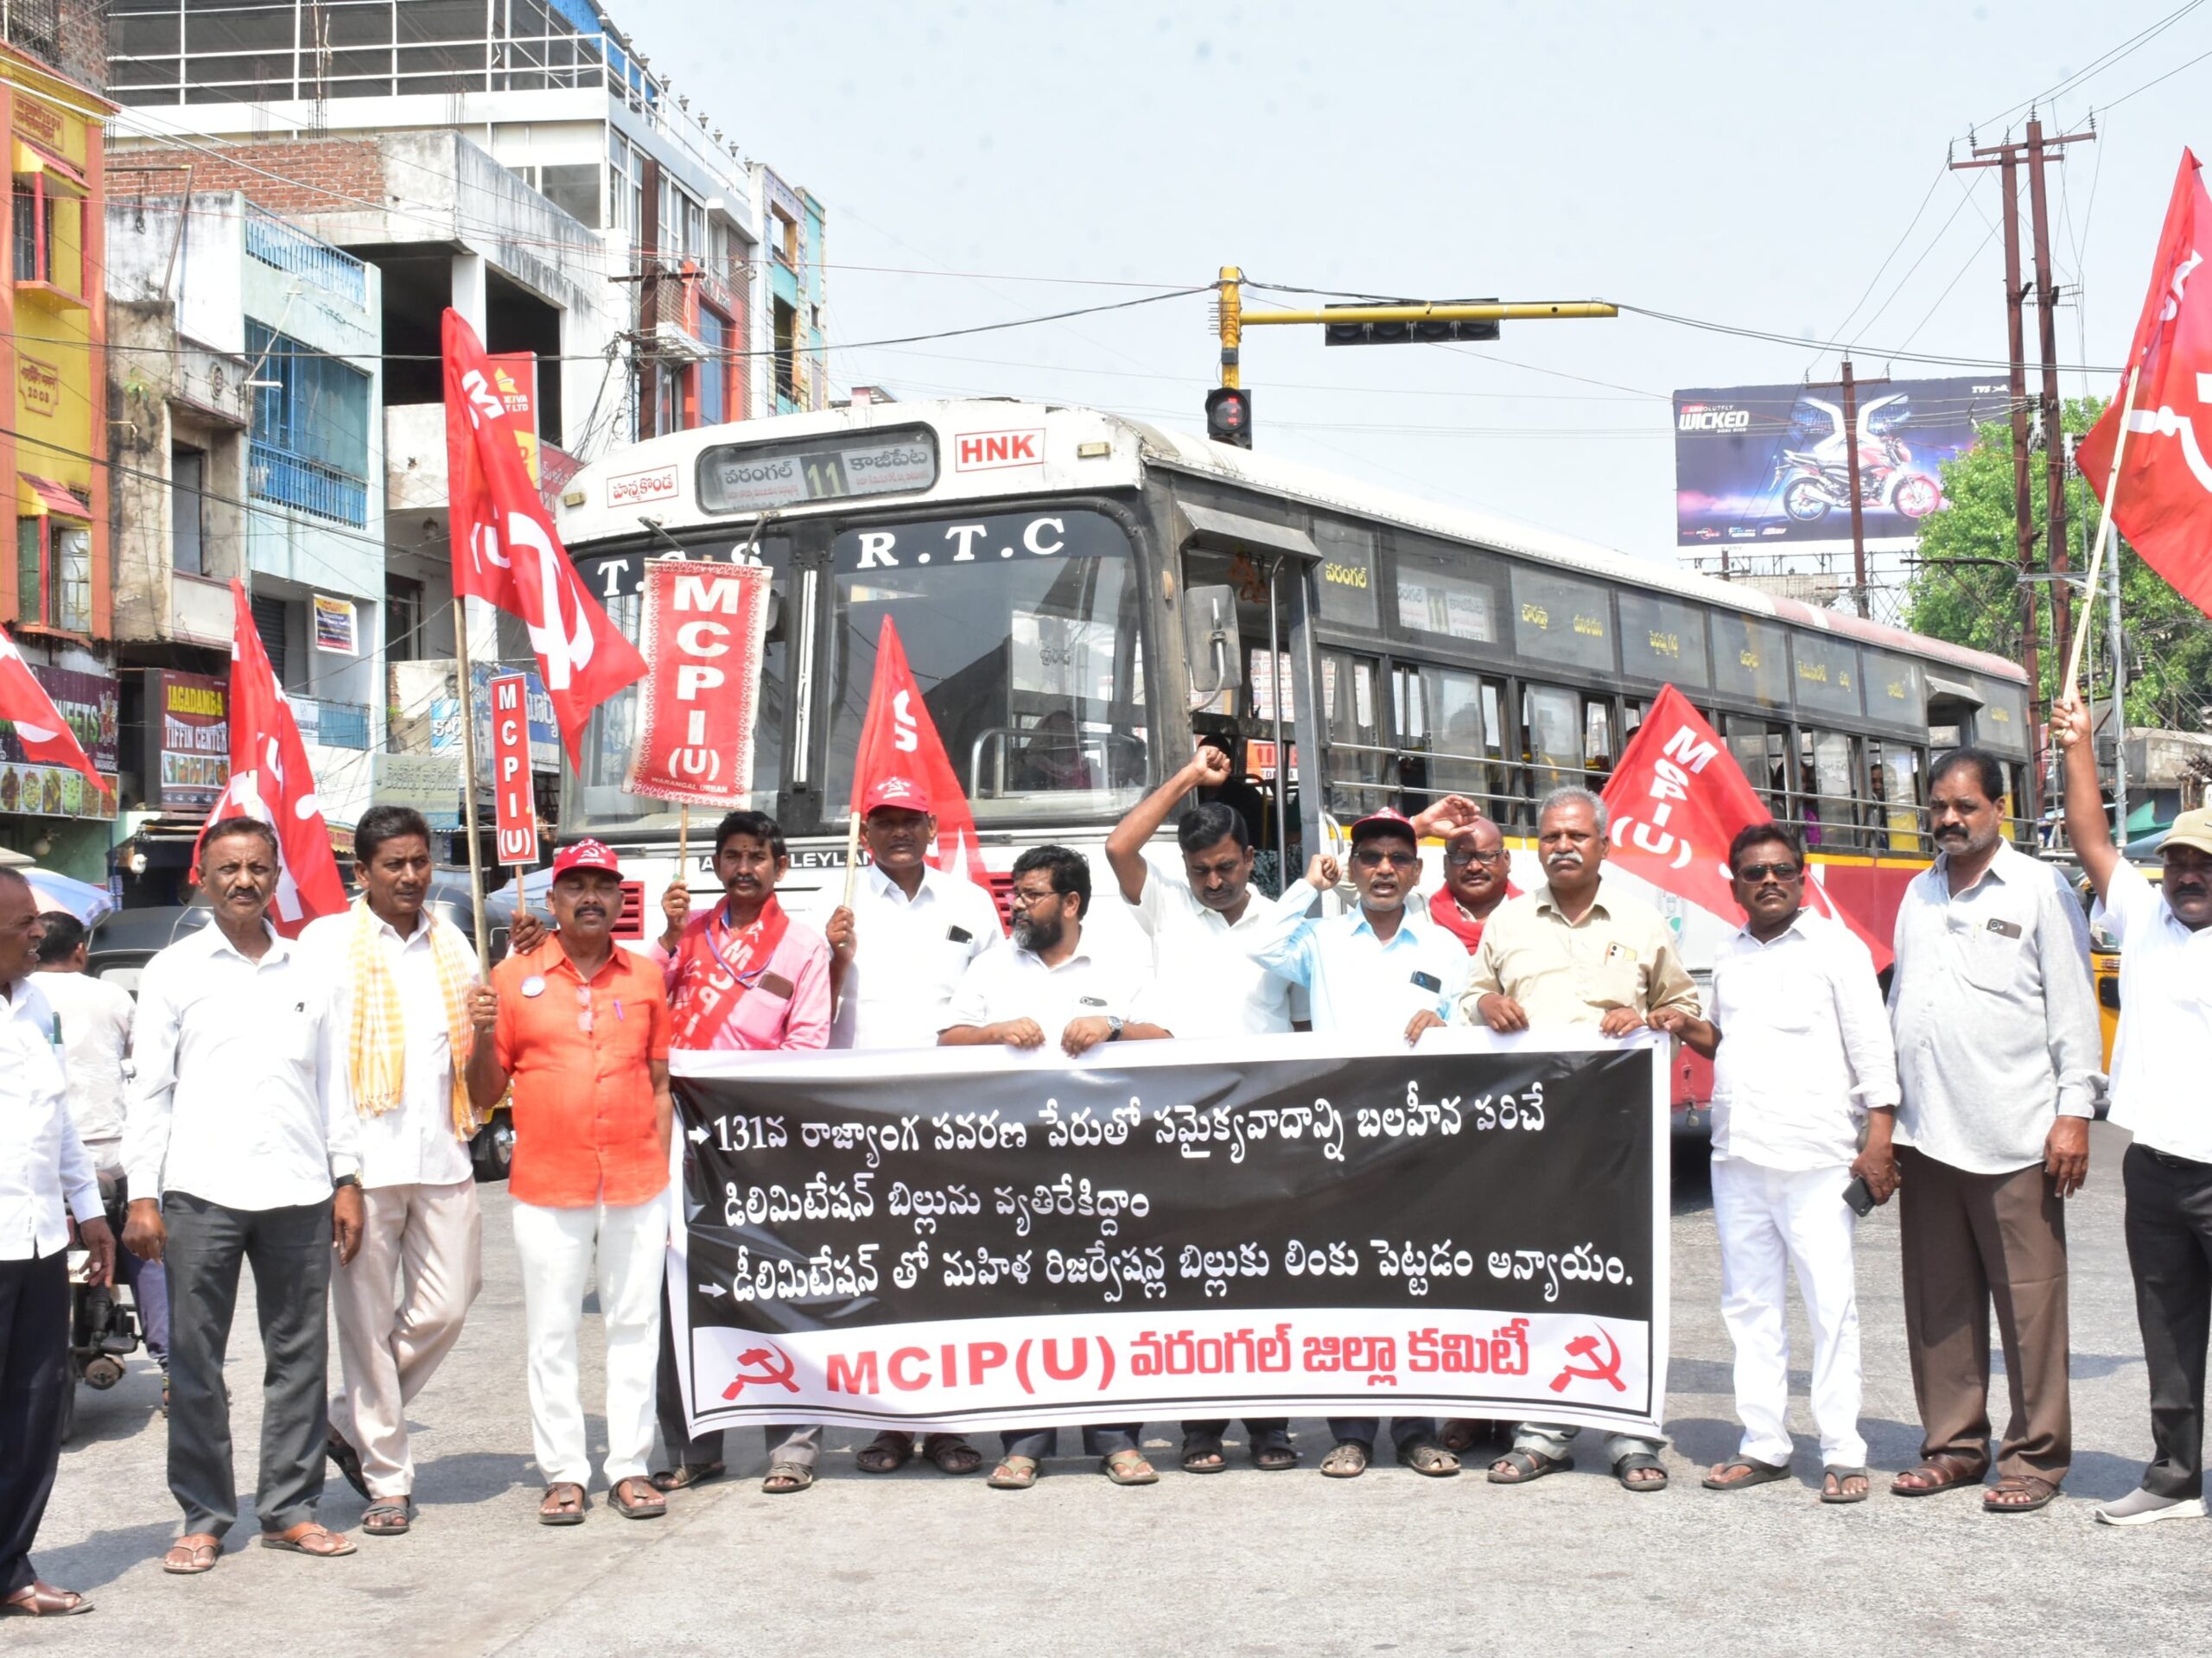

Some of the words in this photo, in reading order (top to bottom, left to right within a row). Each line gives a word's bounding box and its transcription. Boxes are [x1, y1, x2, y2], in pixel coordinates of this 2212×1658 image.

[1972, 385, 1991, 394] TVS
[1679, 410, 1750, 431] WICKED
[961, 435, 1035, 463] HNK
[724, 461, 793, 485] వరంగల్
[807, 461, 845, 499] 11
[848, 448, 928, 472] కాజీపేట
[1325, 562, 1368, 589] వరంగల్
[167, 684, 224, 717] JAGADAMBA
[164, 714, 194, 749] TIFFIN
[194, 721, 228, 753] CENTER
[651, 776, 697, 792] WARANGAL
[699, 783, 728, 794] URBAN
[714, 1114, 789, 1153] 131వ
[801, 1114, 920, 1169] రాజ్యాంగ
[933, 1109, 1028, 1152] సవరణ
[1038, 1096, 1141, 1149] పేరుతో
[1154, 1096, 1345, 1164] సమైక్యవాదాన్ని
[1357, 1080, 1462, 1138] బలహీన
[1475, 1081, 1545, 1132] పరిచే
[724, 1171, 874, 1228] డిలిమిటేషన్
[888, 1181, 981, 1235] బిల్లును
[994, 1172, 1150, 1237] వ్యతిరేకిద్దాం
[893, 1240, 929, 1289] తో
[942, 1245, 1033, 1286] మహిళ
[1046, 1239, 1166, 1303] రిజర్వేషన్ల
[1179, 1242, 1270, 1298] బిల్లుకు
[1284, 1239, 1359, 1276] లింకు
[1370, 1239, 1473, 1296] పెట్టడం
[1487, 1242, 1633, 1303] అన్యాయం.
[826, 1336, 1116, 1395] MCIP(U)
[1130, 1323, 1293, 1376] వరంగల్
[1302, 1329, 1397, 1386] జిల్లా
[1408, 1318, 1530, 1376] కమిటీ
